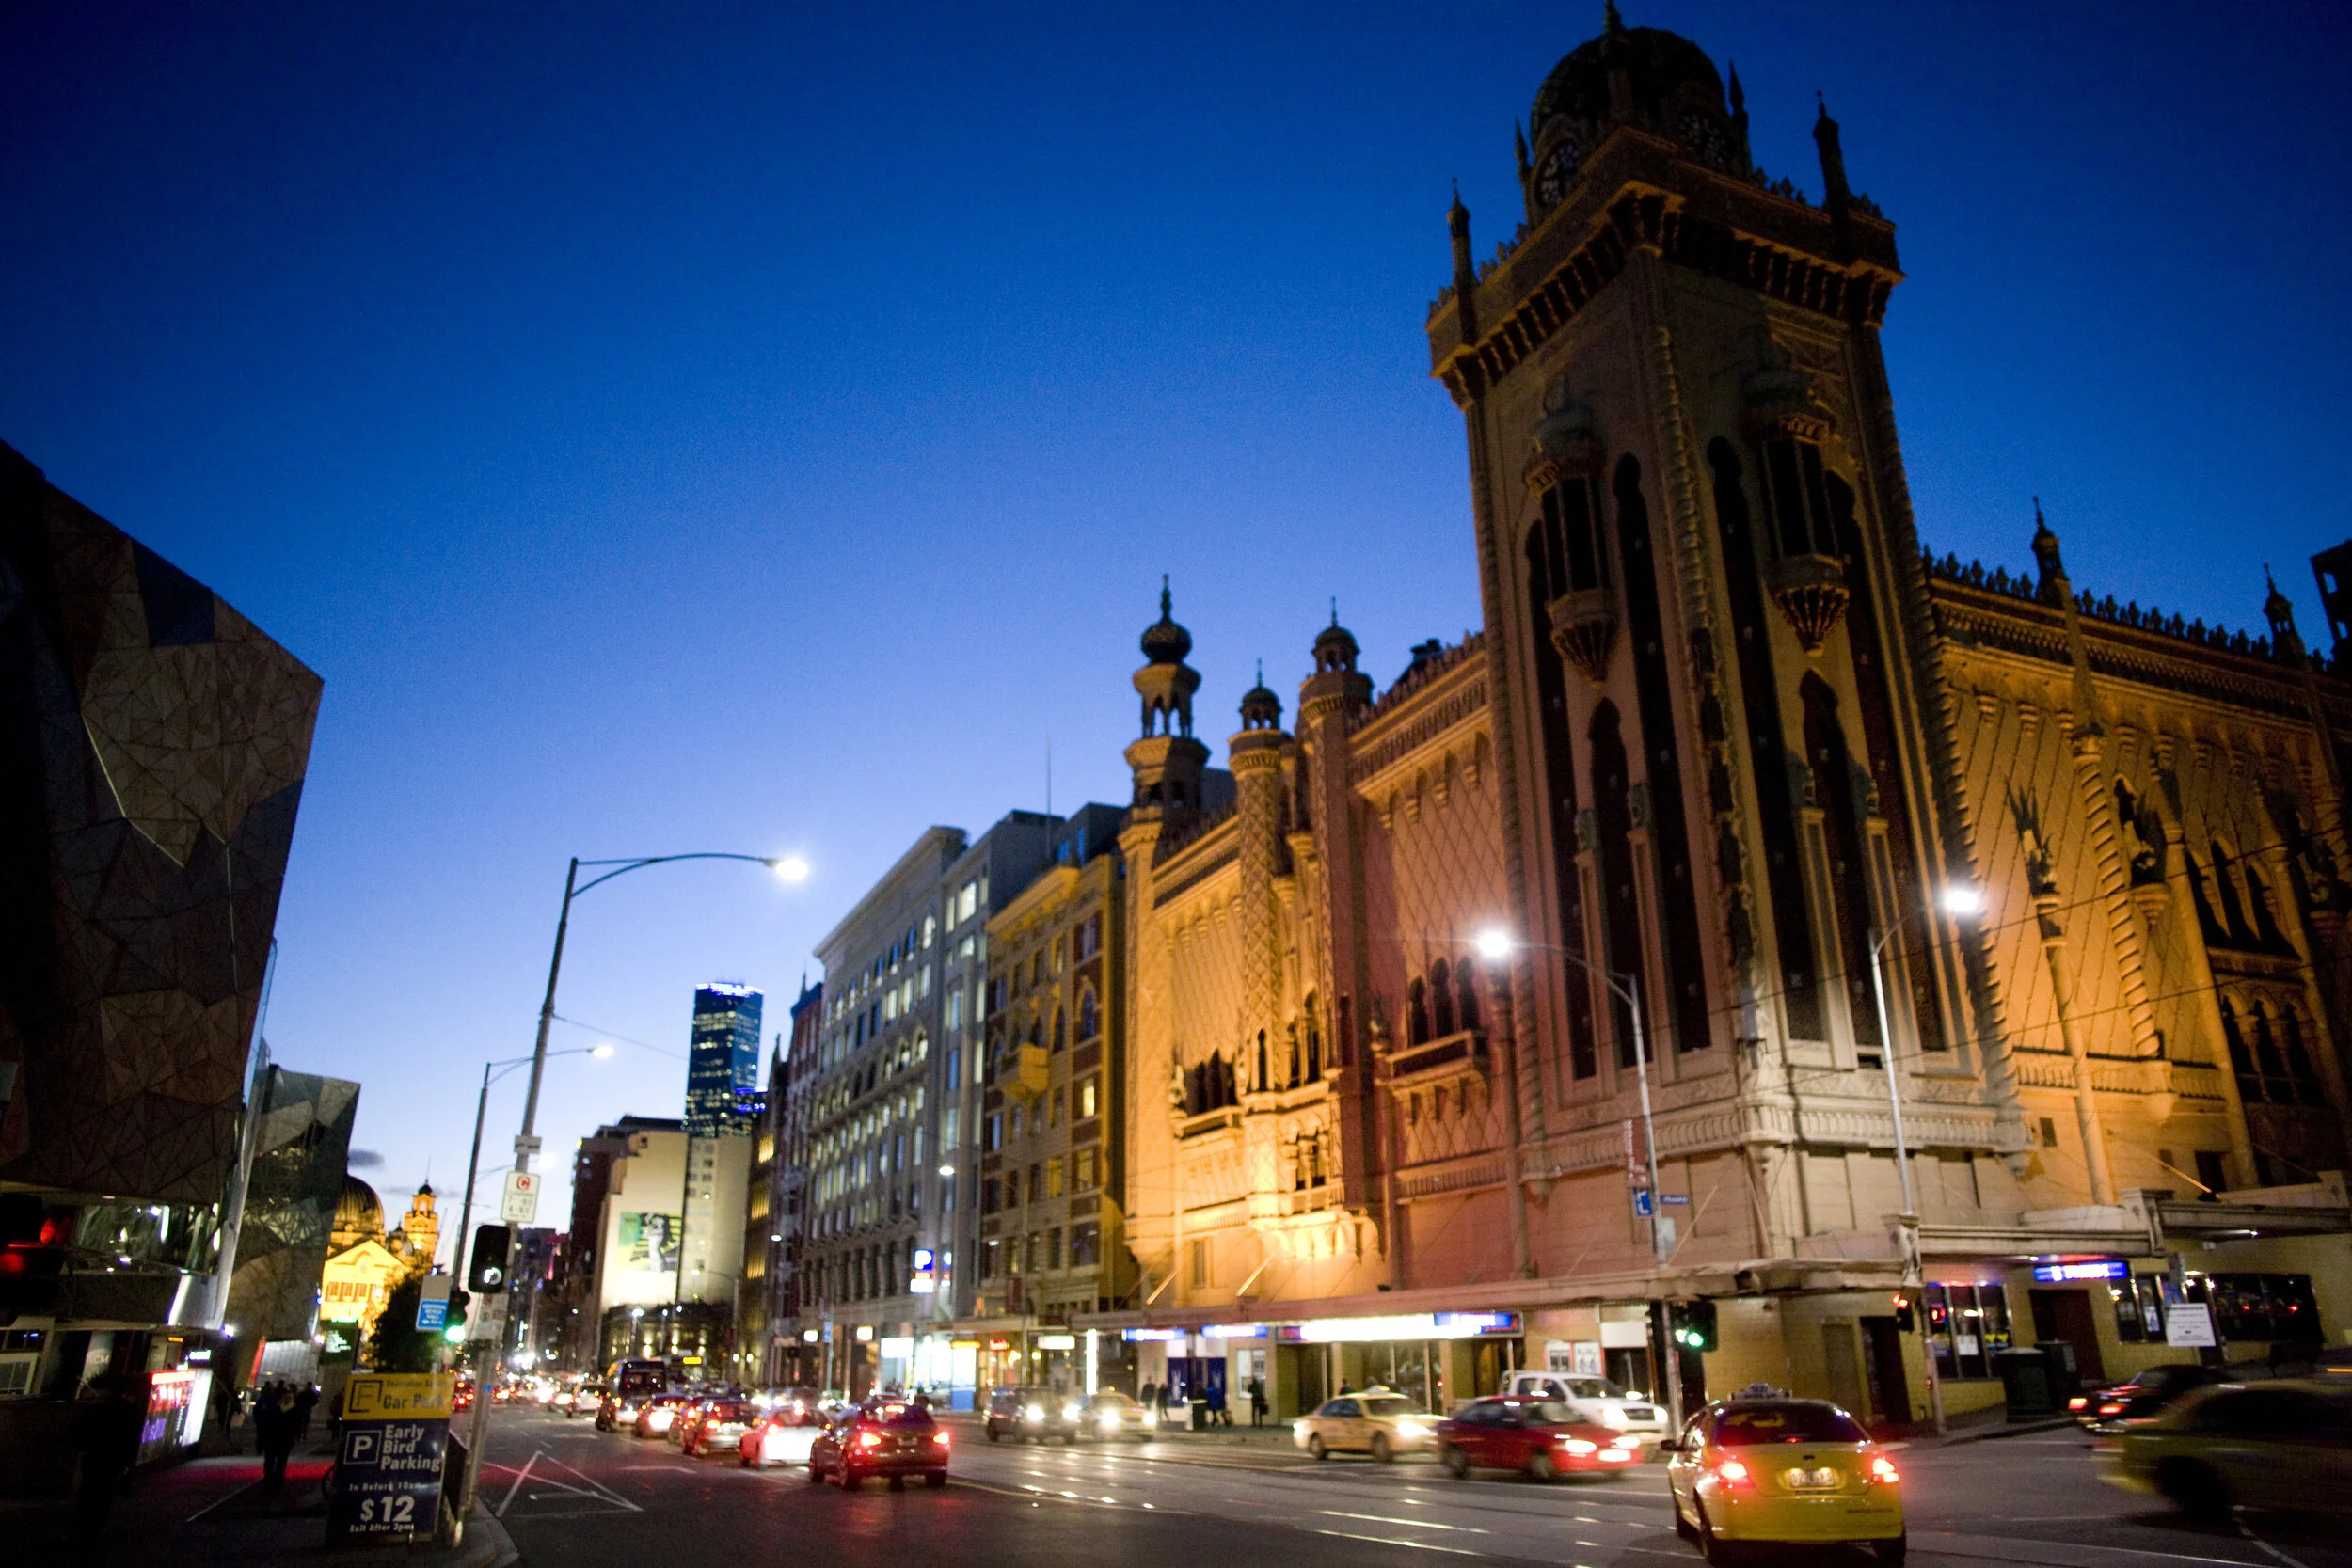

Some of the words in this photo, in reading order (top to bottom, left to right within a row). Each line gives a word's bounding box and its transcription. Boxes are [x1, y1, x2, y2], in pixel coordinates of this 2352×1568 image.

[383, 1394, 407, 1409] Car
[412, 1393, 444, 1408] Park
[385, 1424, 424, 1442] Early
[352, 1435, 373, 1459] P
[382, 1439, 416, 1454] Bird
[380, 1455, 440, 1472] Parking
[350, 1524, 366, 1532] Exit
[369, 1523, 391, 1532] After
